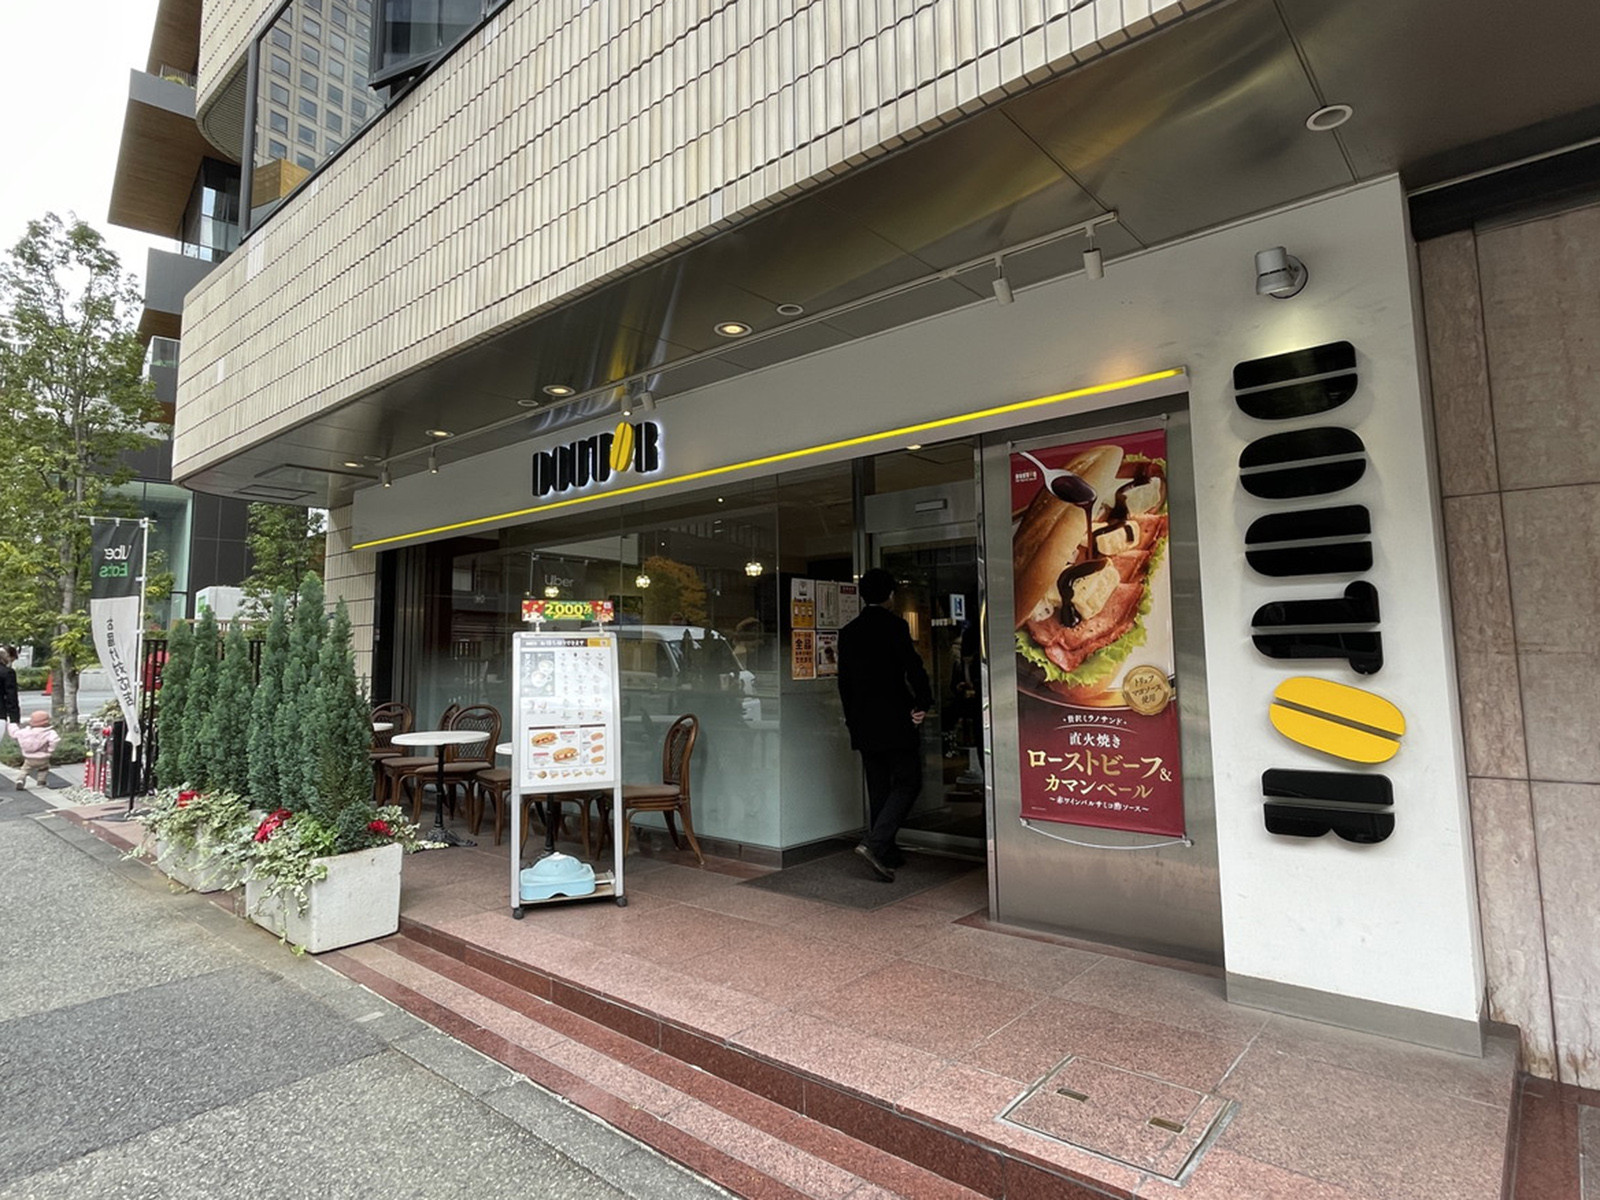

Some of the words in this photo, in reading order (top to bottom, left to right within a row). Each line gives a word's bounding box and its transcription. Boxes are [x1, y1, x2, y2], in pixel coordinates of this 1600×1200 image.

[532, 421, 659, 497] DOUTOR
[544, 574, 574, 587] Uber
[1233, 340, 1406, 845] DOUTOR
[1069, 731, 1121, 748] 直火焼き
[1045, 774, 1153, 798] カマンベール
